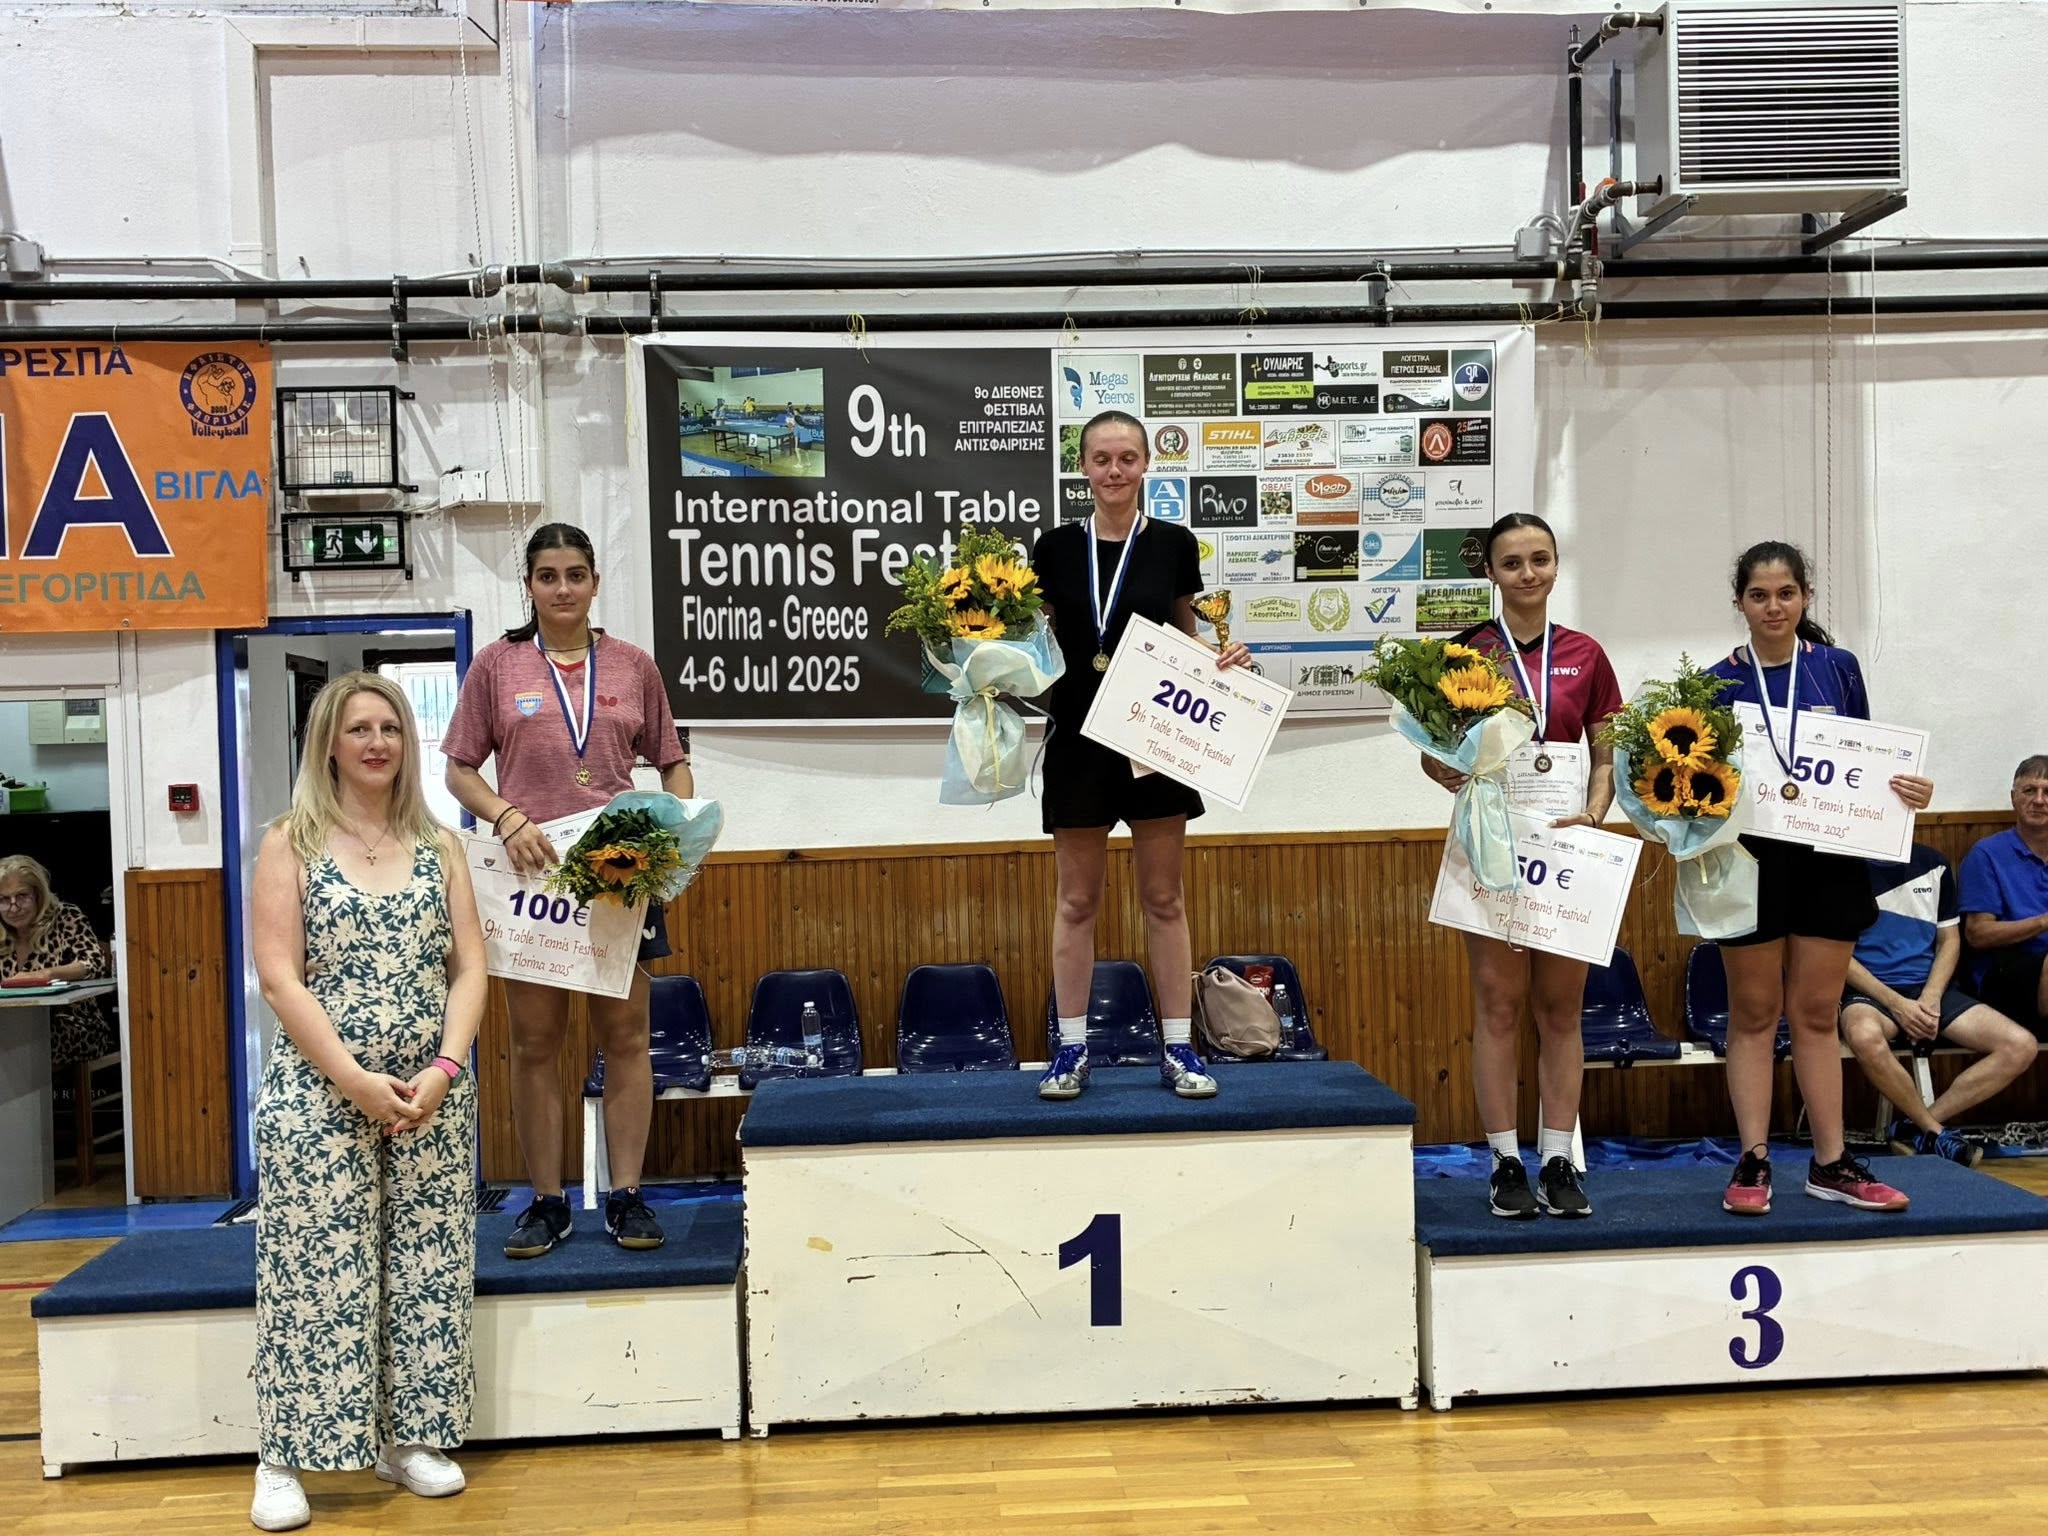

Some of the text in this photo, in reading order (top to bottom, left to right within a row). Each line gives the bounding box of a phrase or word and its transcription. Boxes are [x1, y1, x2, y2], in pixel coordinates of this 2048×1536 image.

[1263, 357, 1304, 371] ΟΥΛΙΑΡΗΣ
[1390, 366, 1415, 374] ΠΕΤΡΟΣ
[1400, 354, 1430, 362] ΛΟΓΙΣΤΙΚΑ
[991, 386, 1045, 399] ΔΙΕΘΝΕΣ
[1089, 371, 1129, 391] Megas
[1094, 389, 1135, 404] Yeeros
[848, 384, 926, 458] 9th
[983, 403, 1046, 417] ΦΕΣΤΙΒΑΛ
[191, 418, 249, 439] Volleyball
[959, 421, 1046, 434] ΕΠΙΤΡΑΠΕΖΙΑΣ
[1207, 430, 1255, 440] STIHL
[954, 438, 1046, 452] ΑΝΤΙΣΦΑΙΡΙΣΗΣ
[155, 470, 263, 501] ΒΙΓΛΑ
[1311, 480, 1347, 496] bloom
[674, 490, 1041, 524] International Table
[1199, 484, 1248, 515] Rivo
[668, 528, 836, 587] Tennis
[682, 595, 763, 641] Florina
[783, 595, 869, 641] Greece
[679, 655, 860, 693] 4-6 Jul 2025
[1550, 667, 1579, 676] EWO
[1126, 701, 1236, 767] 9th Table Tennis Festival
[1790, 755, 1863, 789] 50 €
[1757, 783, 1776, 804] 9th
[1812, 796, 1844, 814] Tennis
[1848, 803, 1885, 821] Festival
[1556, 869, 1574, 890] €
[1523, 896, 1553, 914] Tennis
[1556, 904, 1592, 924] Festival
[484, 918, 608, 959] 9th Table Tennis Festival
[1058, 1213, 1123, 1327] 1
[1728, 1265, 1785, 1371] 3
